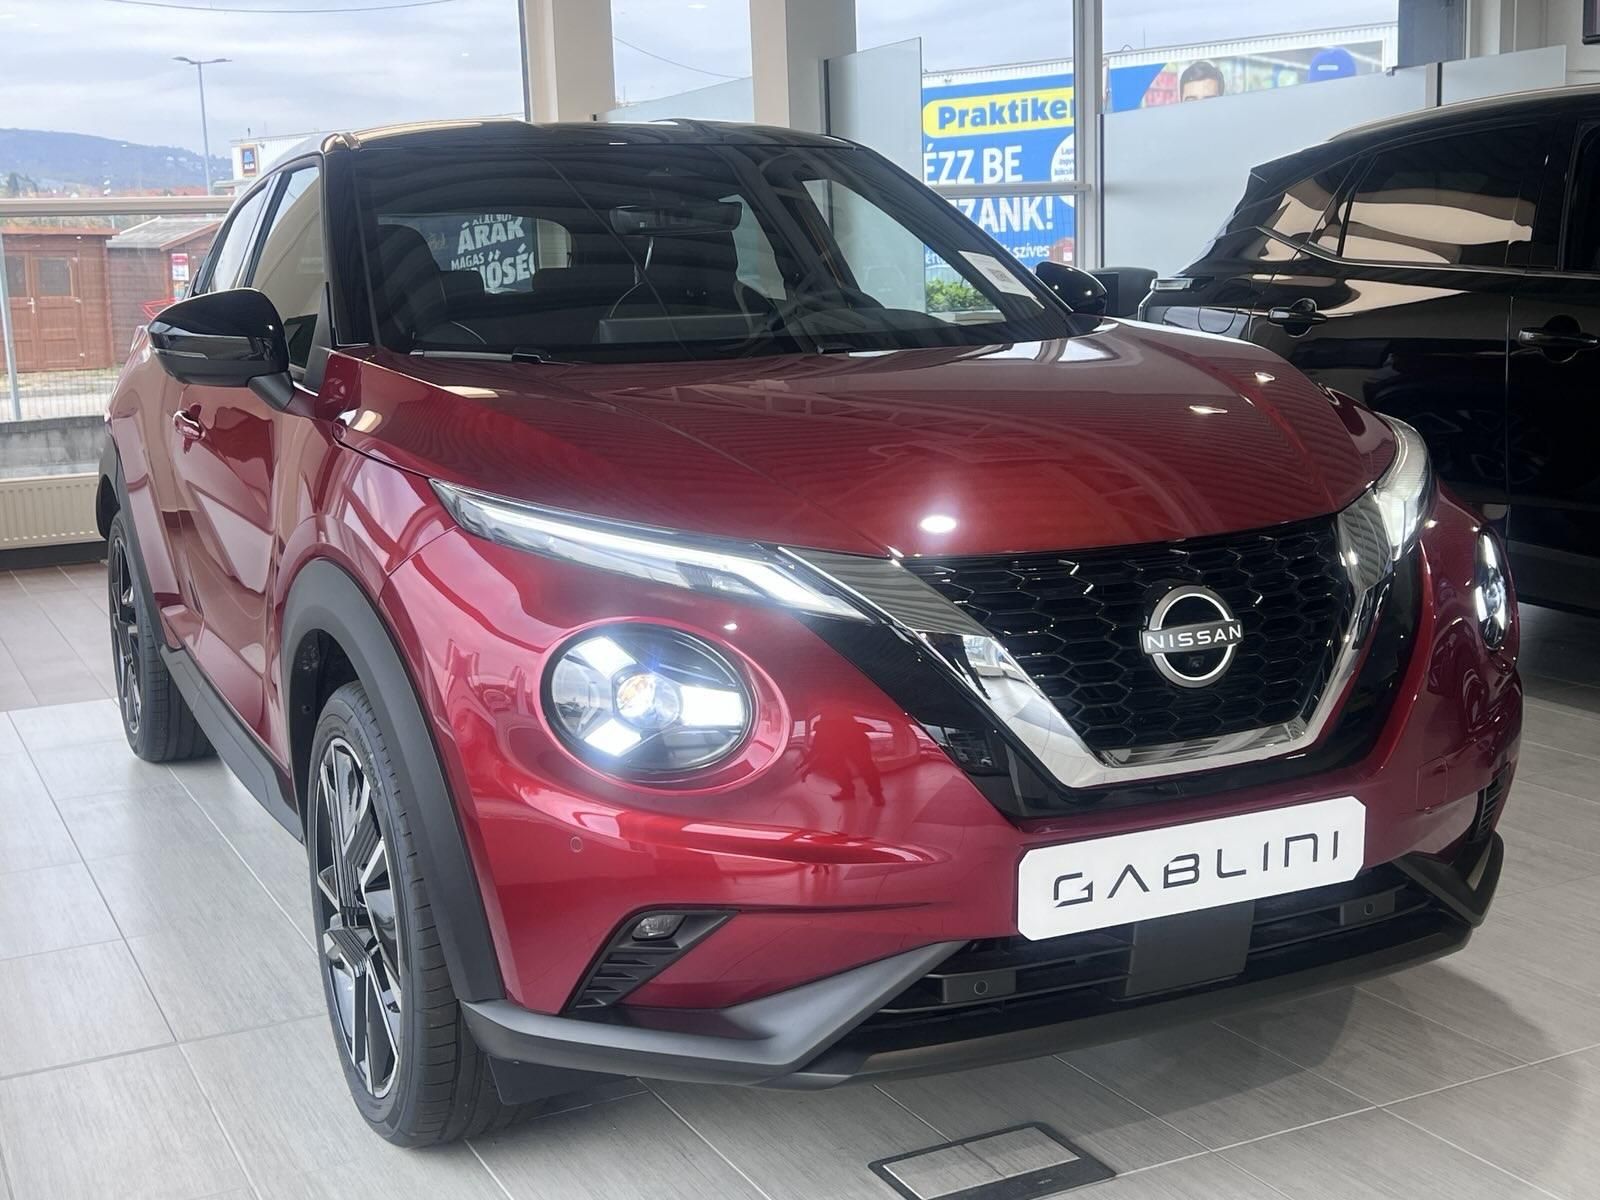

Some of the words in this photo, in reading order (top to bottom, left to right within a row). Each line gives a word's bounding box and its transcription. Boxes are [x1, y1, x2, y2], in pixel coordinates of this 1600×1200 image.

[983, 145, 1023, 184] BE
[457, 216, 525, 254] ÁRAK
[1012, 242, 1050, 258] szíves
[451, 252, 485, 271] MAGAS
[480, 243, 536, 289] ŐSÉ
[1146, 624, 1242, 649] NISSAN
[1053, 830, 1339, 908] GABLINI
